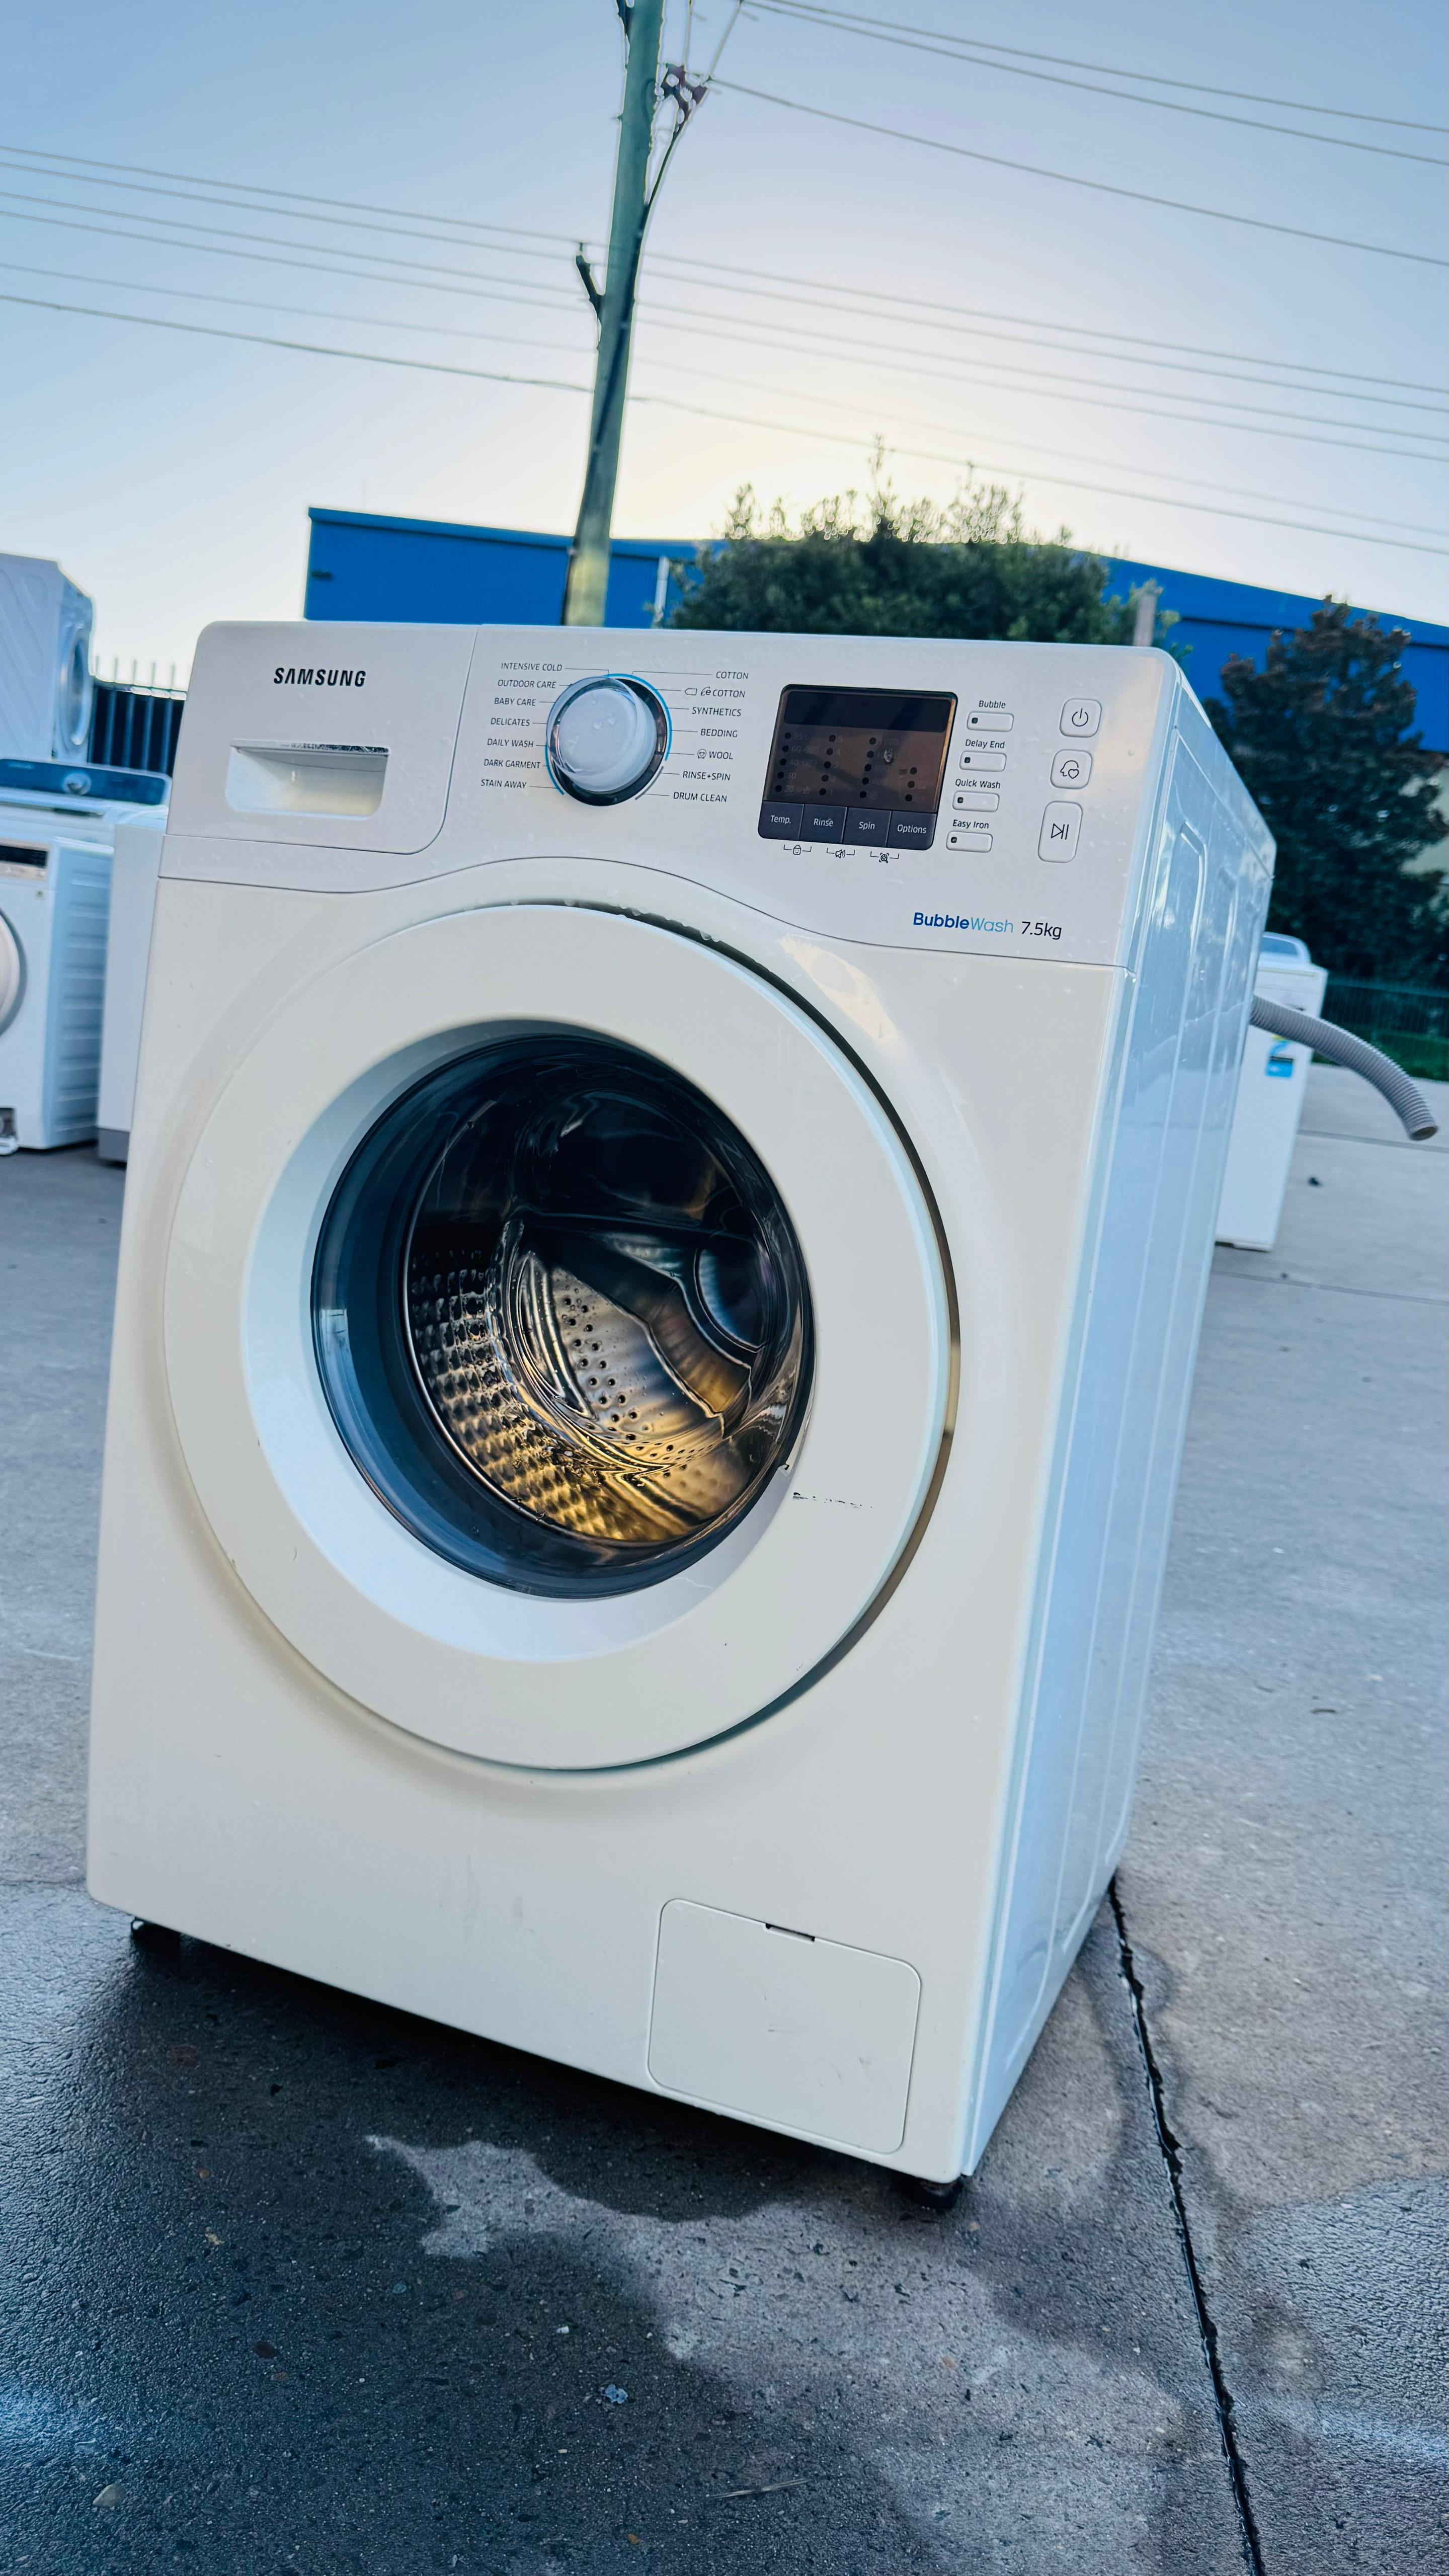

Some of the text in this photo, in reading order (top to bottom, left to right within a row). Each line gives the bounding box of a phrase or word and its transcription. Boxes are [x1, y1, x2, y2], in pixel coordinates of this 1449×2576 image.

[501, 662, 562, 672] INTENSIVE COLD
[273, 667, 366, 687] SAMSUNG
[716, 671, 749, 680] COTTON
[498, 679, 556, 689] OUTDOOR CARE
[516, 698, 536, 706] CARE
[978, 700, 1006, 709] Bubble
[692, 706, 741, 717] SYNTHETICS
[491, 717, 530, 727] DELICATES
[700, 728, 738, 738] BEDDING
[487, 738, 534, 748] DAILY WASH
[965, 739, 1005, 749] Delay End
[709, 751, 733, 760] WOOL
[484, 759, 541, 769] DARK GARMENT
[682, 771, 731, 781] RINSE+SPIN
[480, 779, 527, 789] STAIN AWAY
[955, 778, 1001, 789] Quick Wash
[673, 791, 727, 802] DRUM CLEAN
[770, 815, 791, 825] Temp.
[814, 818, 834, 827] Rinse
[952, 819, 989, 829] Easy Iron
[858, 821, 875, 831] Spin
[897, 824, 927, 834] Options
[1021, 921, 1062, 940] 7.5kg
